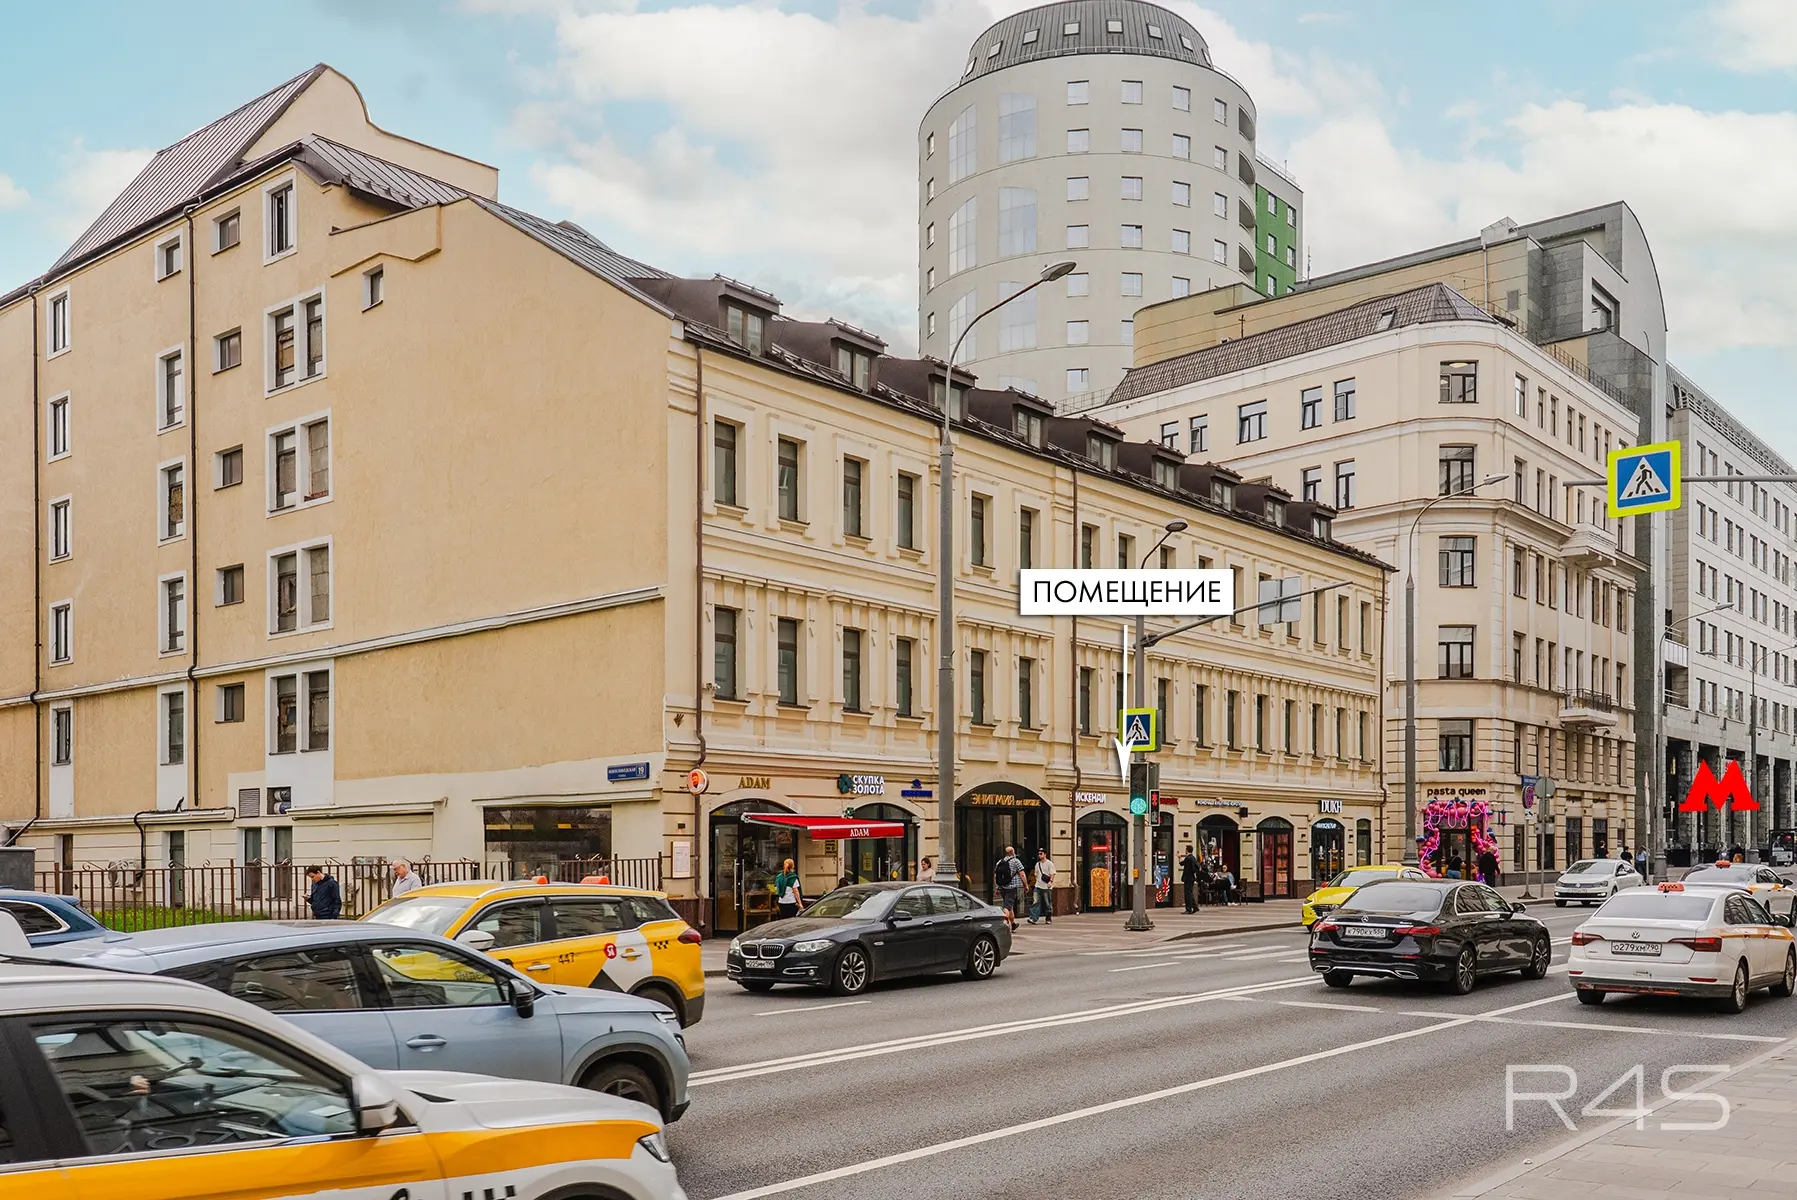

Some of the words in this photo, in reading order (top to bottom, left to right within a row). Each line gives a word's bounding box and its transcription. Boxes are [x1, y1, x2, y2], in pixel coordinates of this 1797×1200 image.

[638, 766, 645, 775] 19
[738, 776, 771, 790] ADAM
[852, 775, 885, 785] СКУПКА
[852, 784, 885, 795] ЗОЛОТА
[1427, 787, 1456, 798] pasta
[1458, 788, 1487, 798] queen
[1321, 800, 1343, 813] DUKH
[850, 828, 870, 837] ADAM
[606, 945, 615, 957] Я
[558, 952, 575, 965] 447
